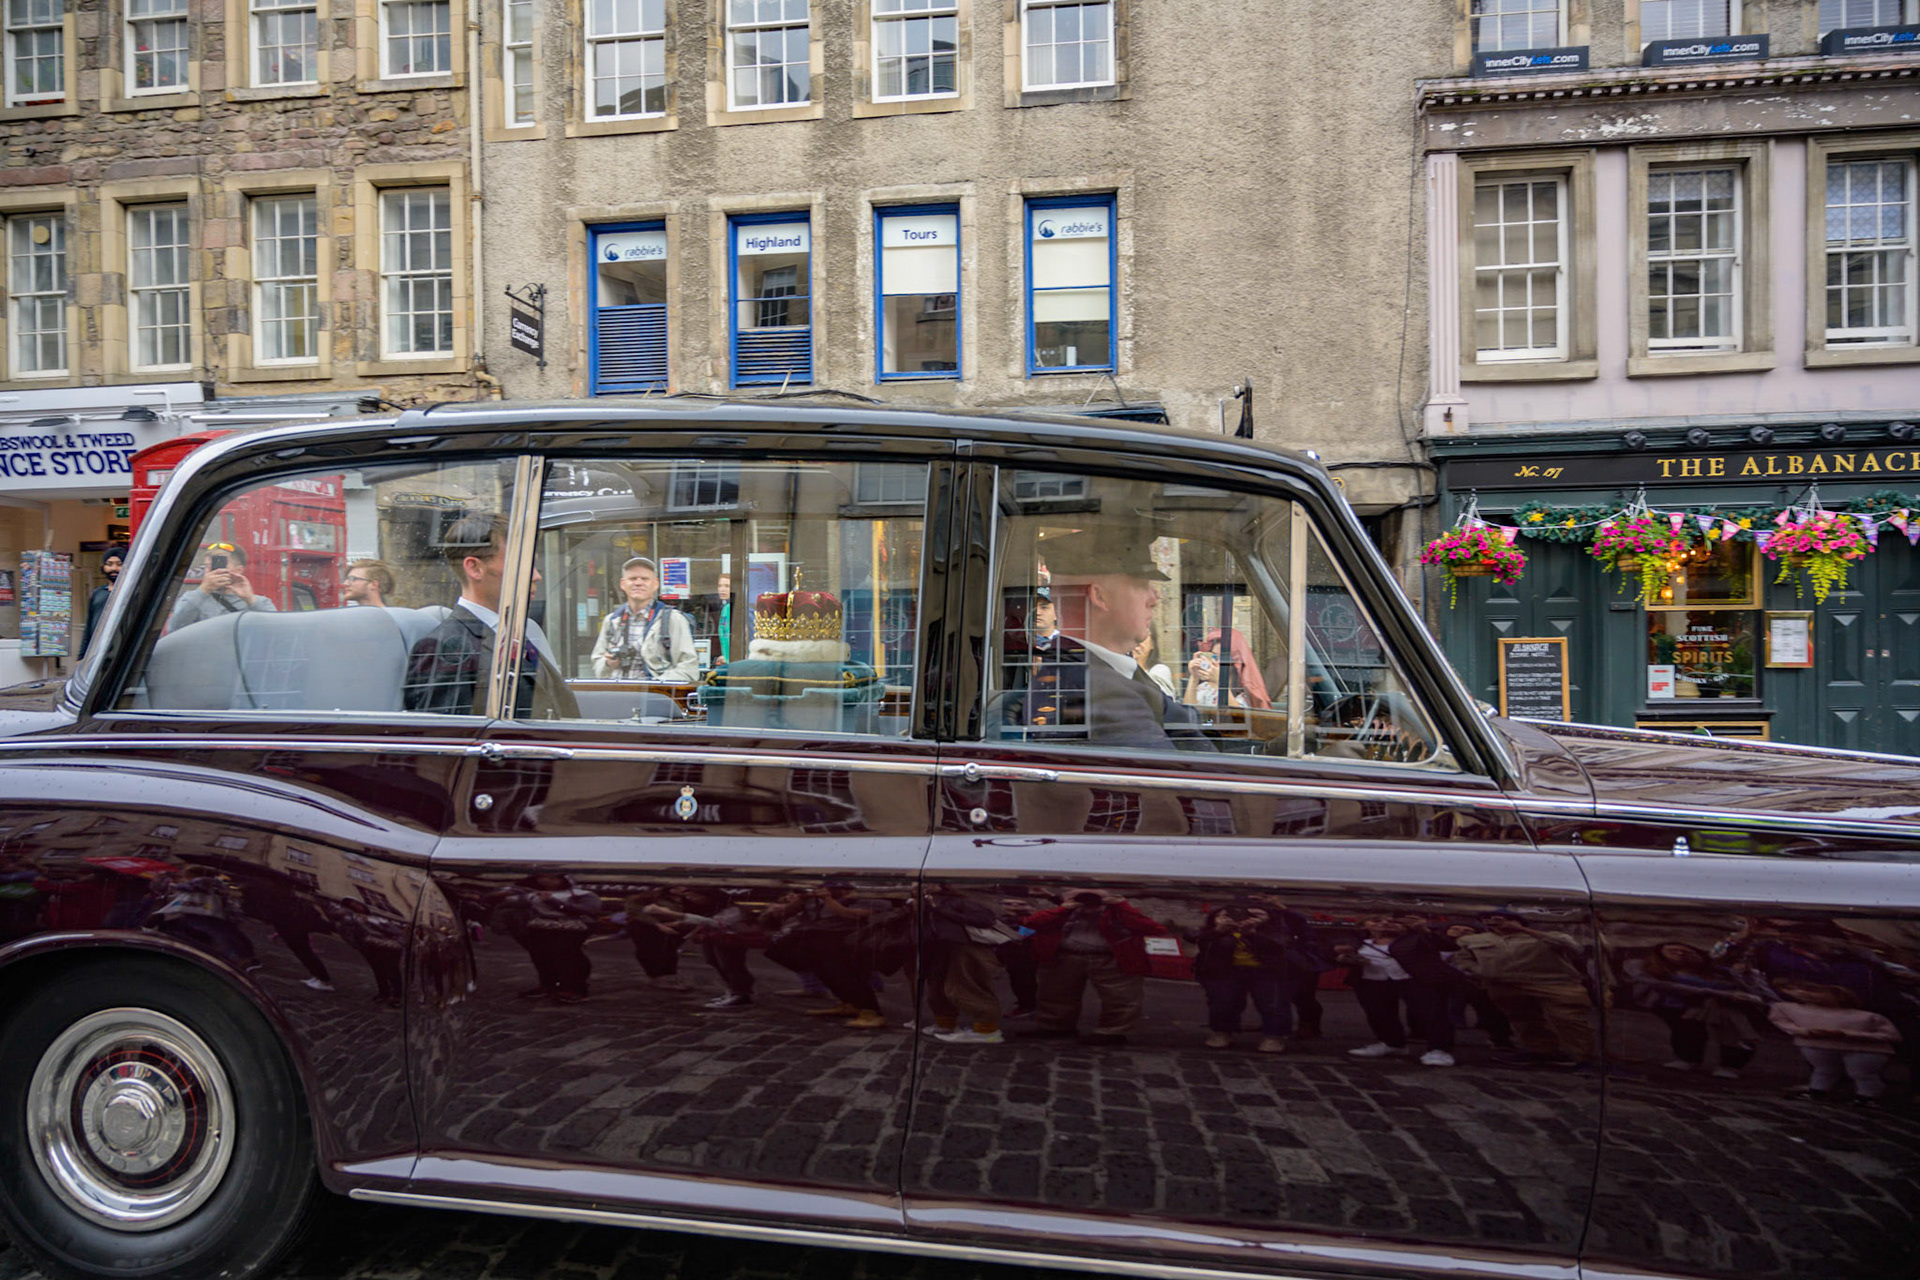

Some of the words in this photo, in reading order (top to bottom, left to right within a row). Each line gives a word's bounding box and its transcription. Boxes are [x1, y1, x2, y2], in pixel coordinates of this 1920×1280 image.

[1662, 43, 1760, 56] innerCityLets.com
[1485, 54, 1580, 67] innerCityLets.com
[902, 229, 938, 240] Tours
[1060, 222, 1103, 234] rabbie's
[745, 234, 802, 251] Highland
[624, 245, 663, 257] rabbie's
[65, 434, 77, 448] &
[77, 432, 135, 448] TWEED
[1656, 457, 1726, 477] THE
[1675, 634, 1729, 642] SCOTTISH
[1671, 651, 1734, 664] SPIRITS
